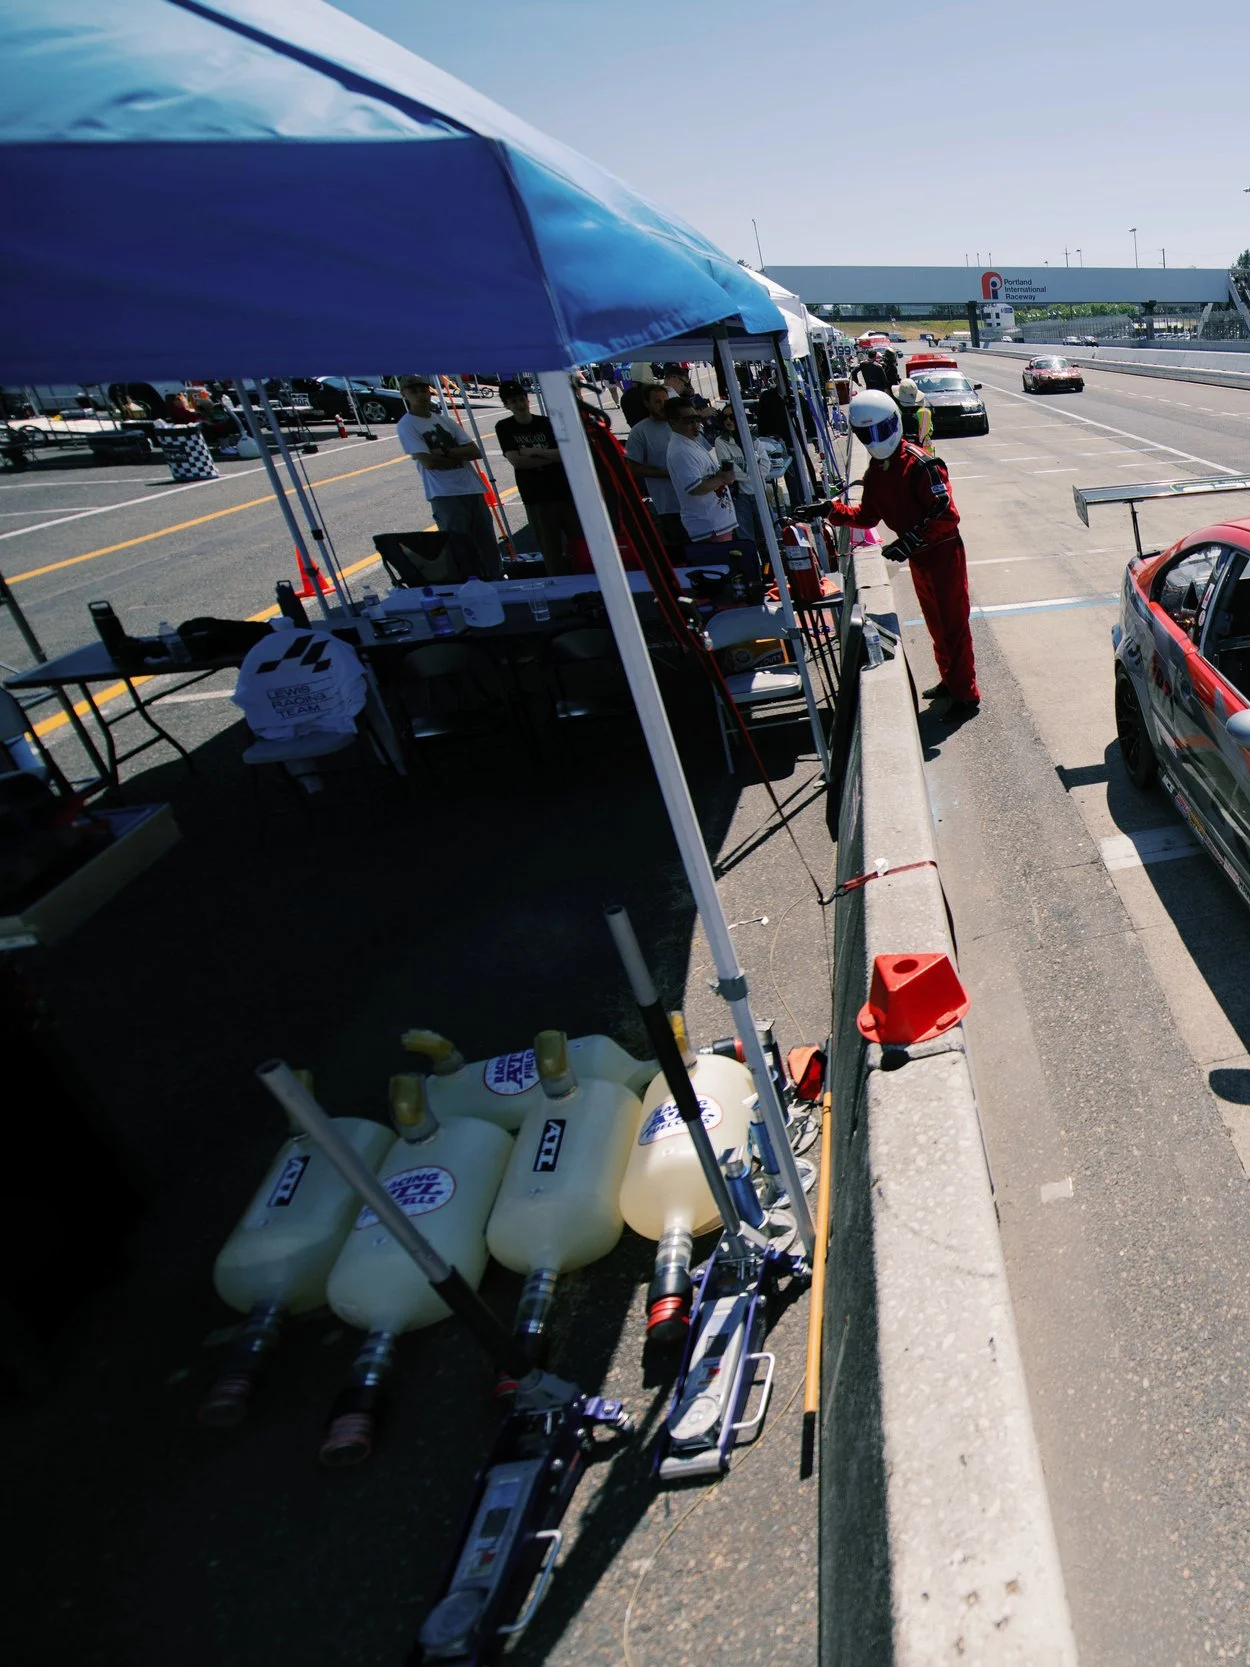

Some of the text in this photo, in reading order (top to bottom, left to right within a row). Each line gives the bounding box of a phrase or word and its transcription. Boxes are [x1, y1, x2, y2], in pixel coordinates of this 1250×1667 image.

[1003, 278, 1033, 286] Portland
[1005, 293, 1036, 301] Raceway
[834, 345, 852, 357] 199
[271, 692, 328, 708] RACING
[276, 704, 322, 718] TEAM
[535, 1121, 562, 1170] ATL
[387, 1173, 440, 1190] ACING
